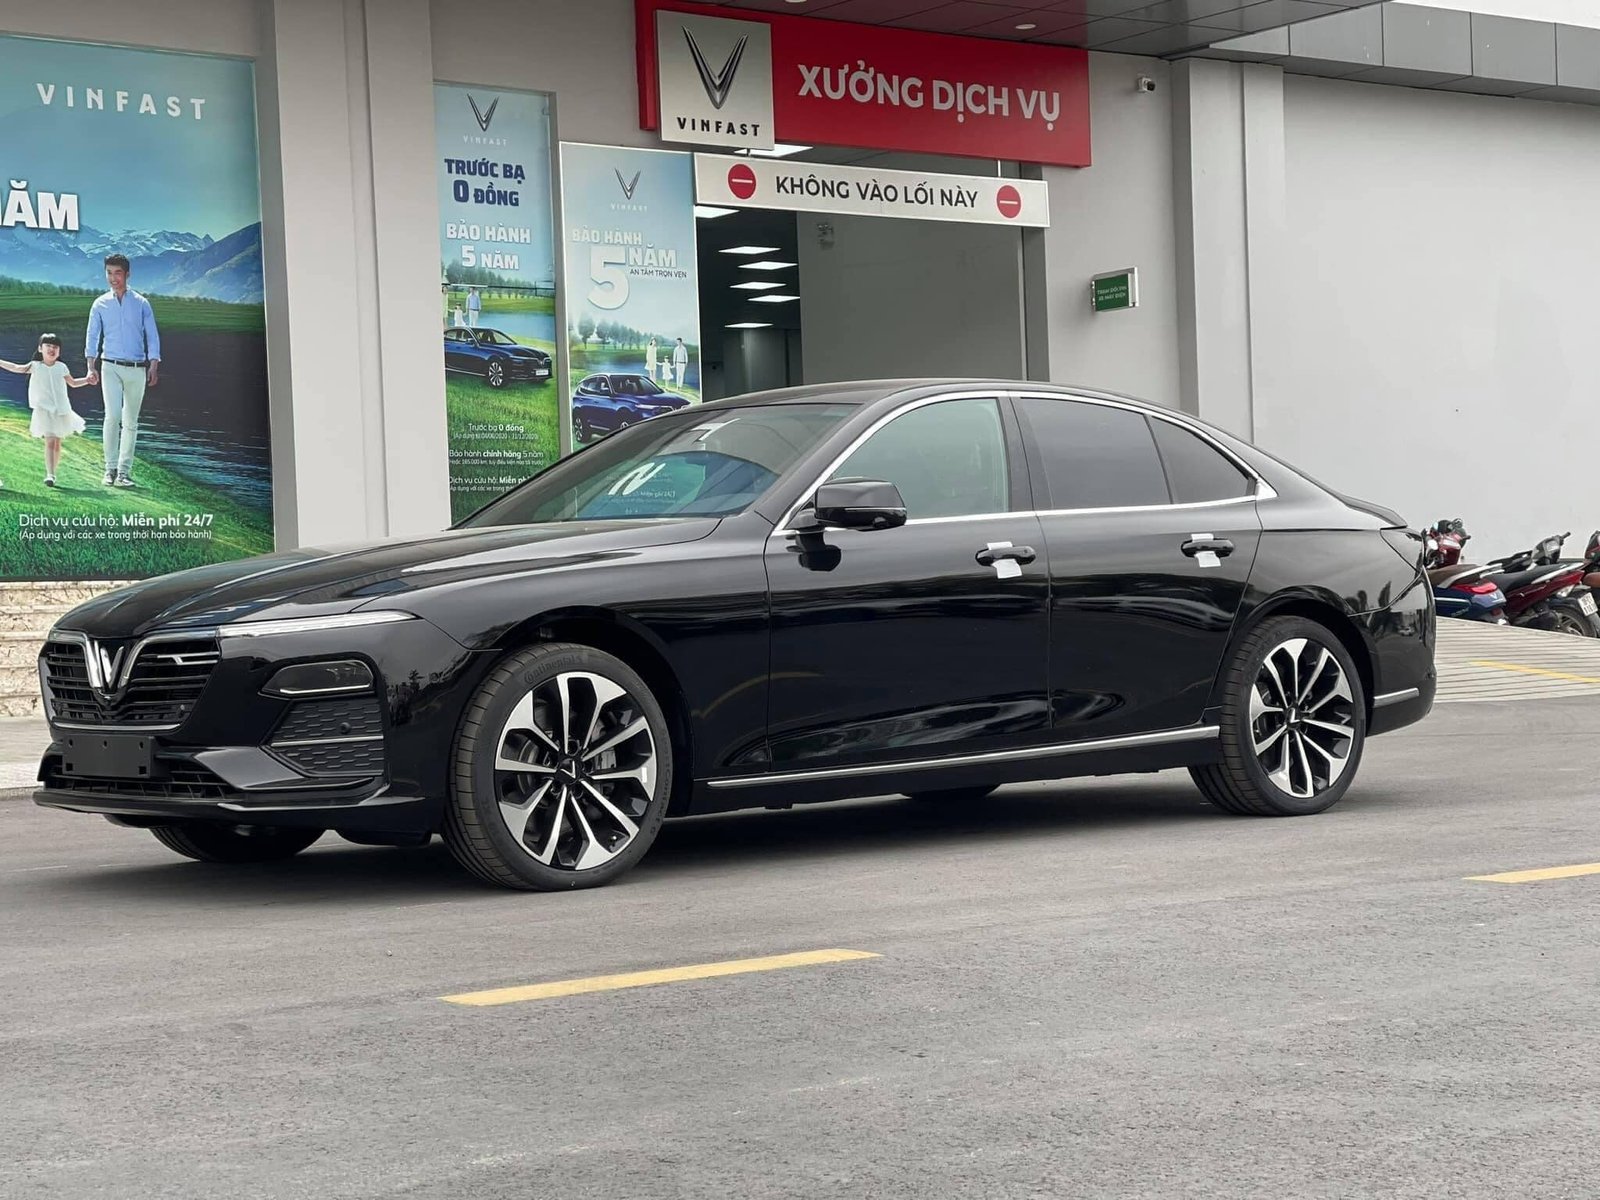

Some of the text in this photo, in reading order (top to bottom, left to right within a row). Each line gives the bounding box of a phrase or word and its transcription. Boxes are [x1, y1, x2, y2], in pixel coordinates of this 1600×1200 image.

[36, 82, 206, 120] VINFAST
[797, 59, 1061, 131] XƯỞNG DỊCH VỤ
[463, 134, 508, 147] VINFAST
[677, 117, 760, 137] VINFAST
[444, 157, 526, 186] TRƯỚC BẠ
[0, 179, 79, 231] ĂM
[473, 181, 520, 208] ĐỒNG
[775, 174, 979, 209] KHÔNG VÀO LỐI NÀY
[446, 218, 532, 245] BẢO HÀNH
[572, 225, 643, 246] BẢO HÀNH
[461, 244, 519, 271] 5 NĂM
[587, 243, 677, 311] 5 NĂM
[19, 511, 213, 529] Dịch vụ cứu hộ: Miễn phí 24/7
[19, 528, 36, 541] (Áp
[37, 530, 60, 541] dụng
[62, 530, 76, 539] với
[77, 529, 93, 539] các
[108, 530, 131, 541] trong
[133, 530, 149, 539] thời
[151, 530, 168, 541] hạn
[188, 529, 212, 541] hành)
